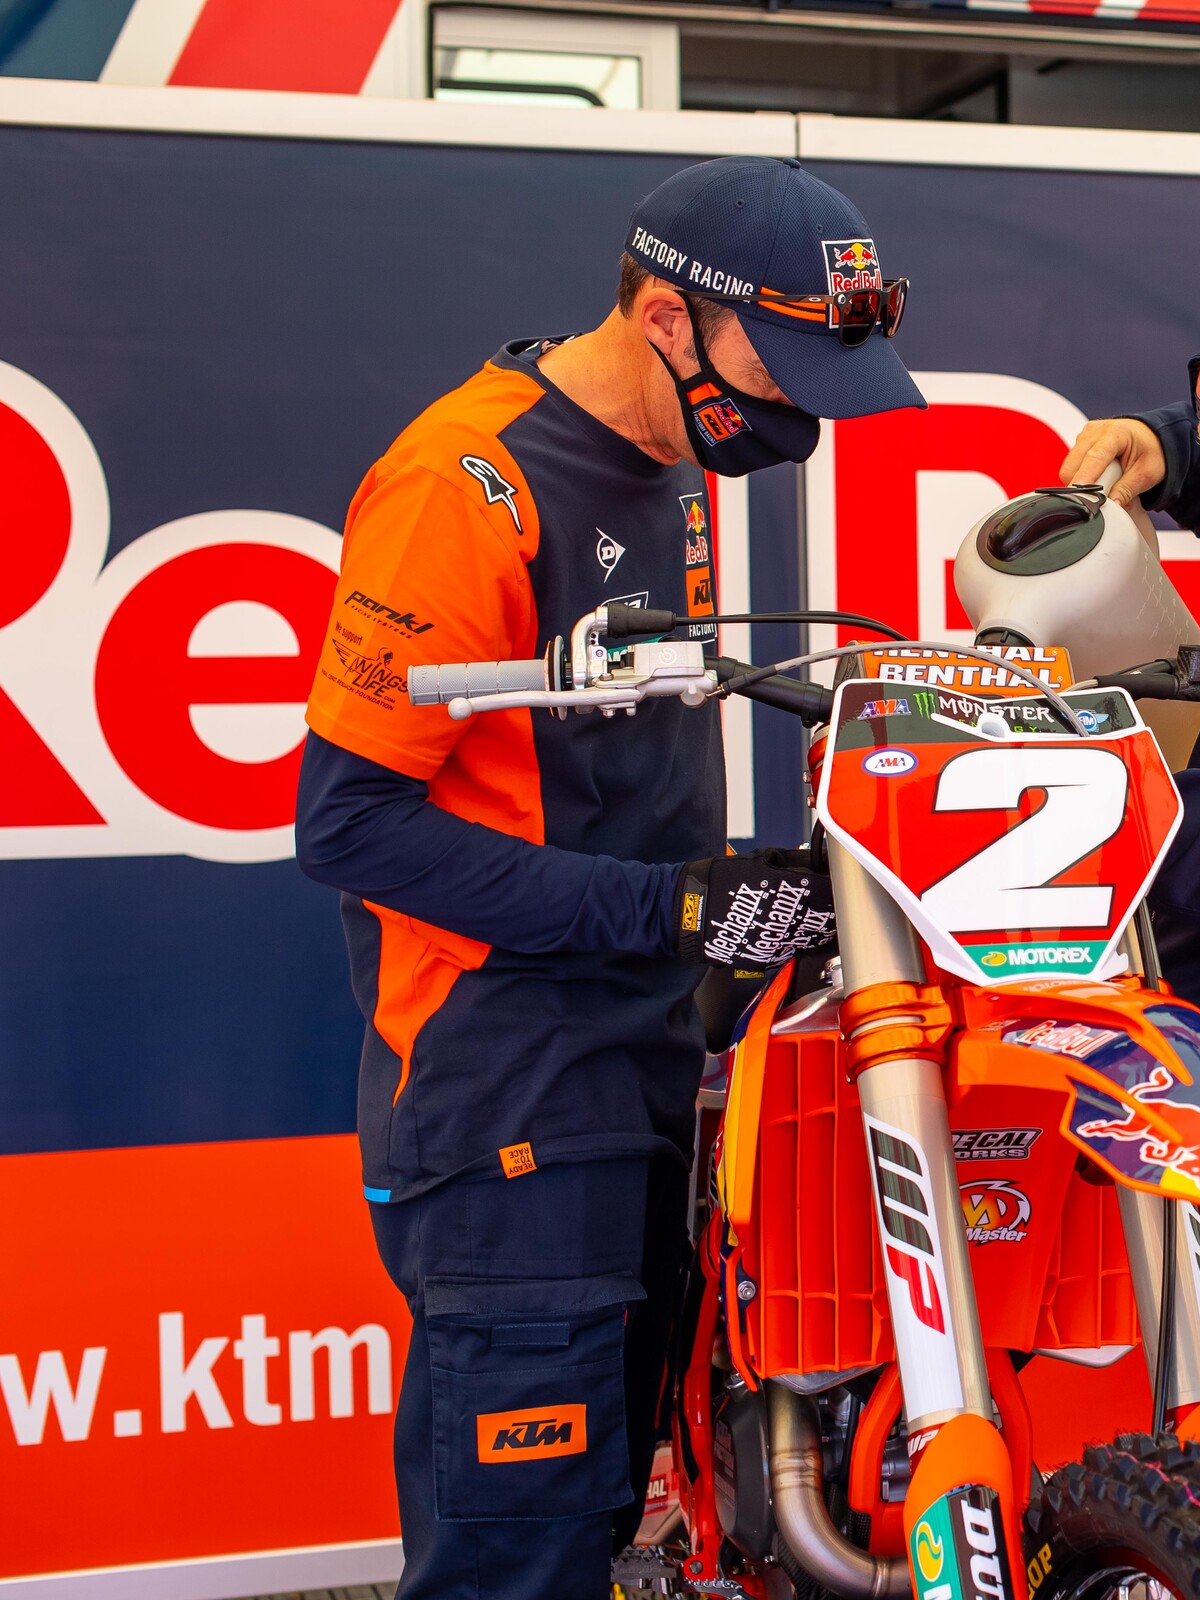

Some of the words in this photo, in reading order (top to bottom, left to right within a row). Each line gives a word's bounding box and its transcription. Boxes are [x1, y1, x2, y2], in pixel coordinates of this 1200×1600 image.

[631, 226, 688, 274] FACTORY
[689, 260, 754, 304] RACING
[831, 270, 861, 292] Red
[693, 579, 712, 606] KT
[879, 663, 1061, 689] RENTHAL
[355, 689, 394, 711] FOUNDATION
[857, 698, 912, 720] AMA
[874, 756, 906, 769] AMA
[920, 746, 1129, 934] 2
[704, 883, 764, 963] Mechanix
[740, 880, 806, 963] Mechanix
[1007, 946, 1093, 966] MOTOREX
[954, 1149, 1026, 1159] ORKS
[966, 1226, 1028, 1243] Master
[491, 1418, 573, 1451] KTM
